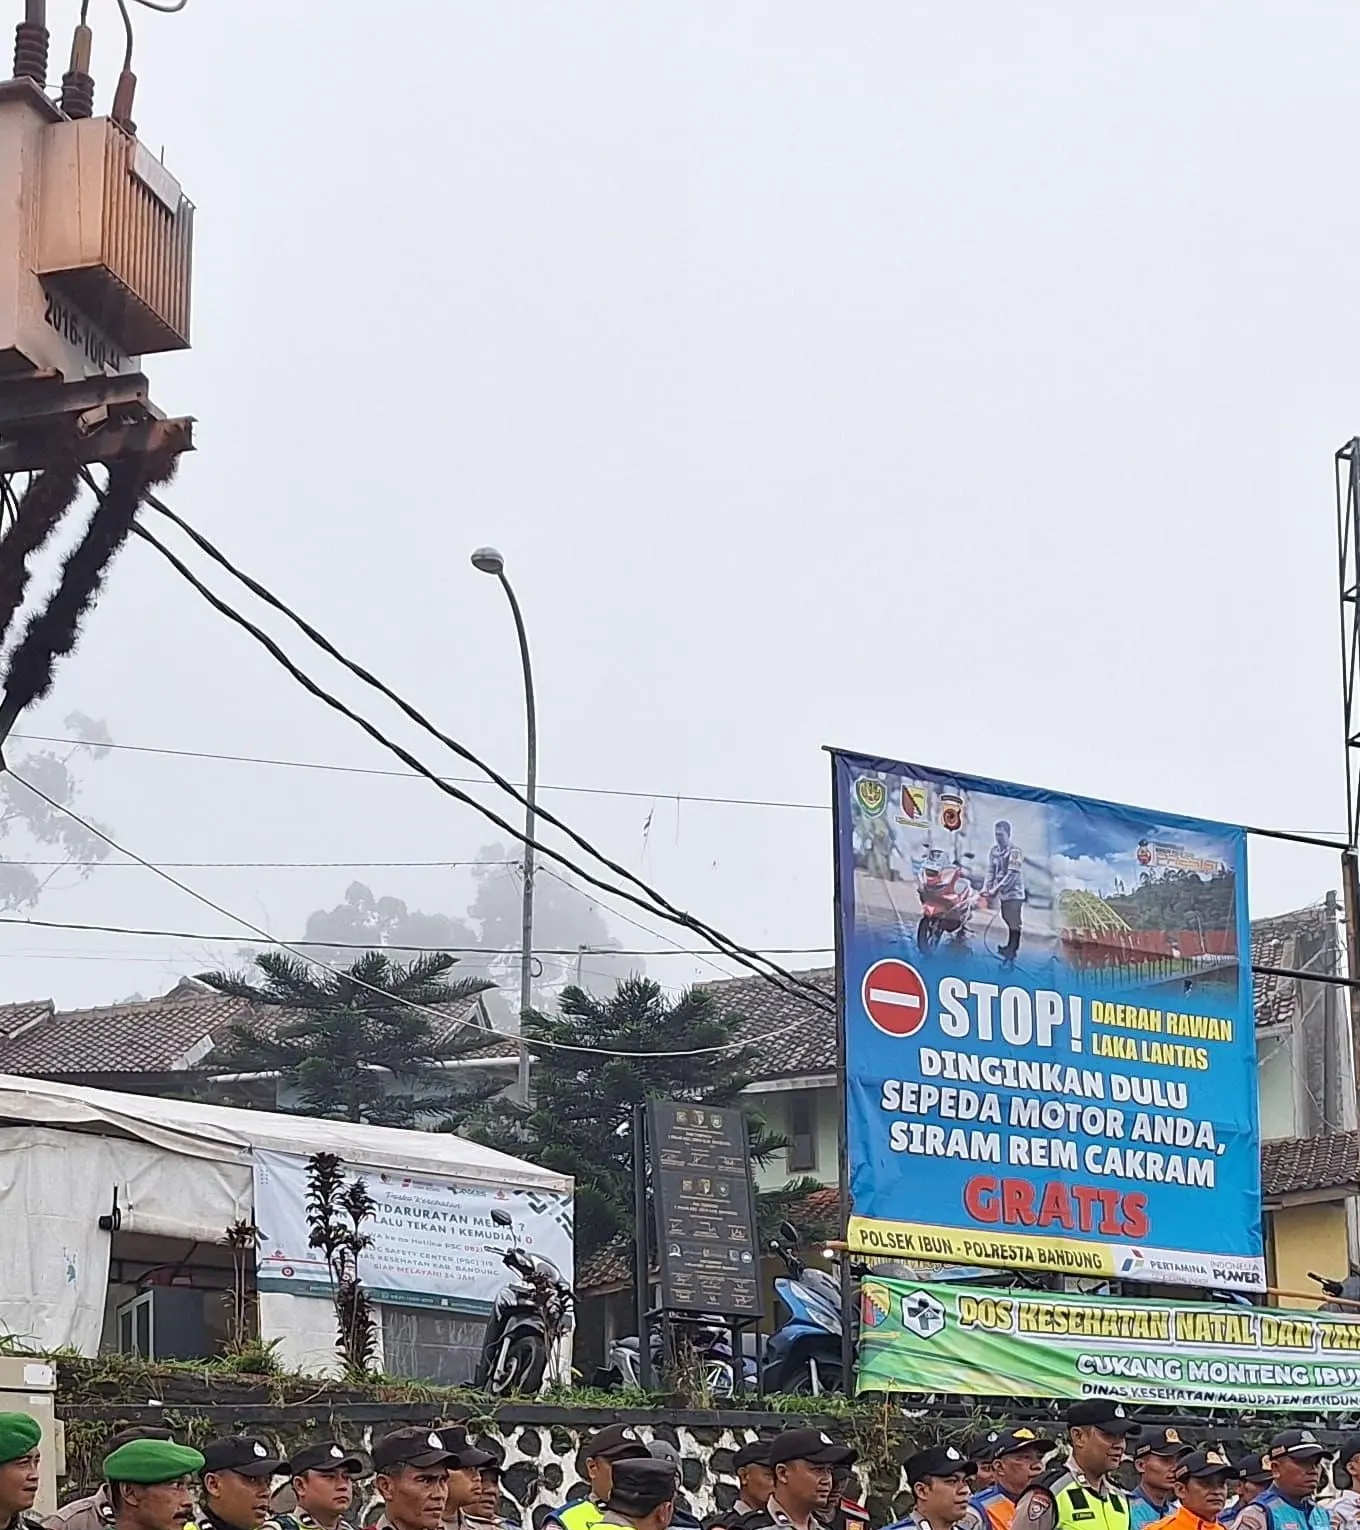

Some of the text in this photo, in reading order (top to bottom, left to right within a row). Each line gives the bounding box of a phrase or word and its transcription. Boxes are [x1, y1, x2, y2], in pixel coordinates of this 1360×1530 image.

[938, 977, 1082, 1053] STOP!
[1091, 1000, 1233, 1042] DAERAH RAWAN
[1092, 1034, 1209, 1071] LAKA LANTAS
[920, 1047, 1188, 1110] DINGINKAN DULU
[880, 1079, 1226, 1155] SEPEDA MOTOR ANDA,
[889, 1120, 1215, 1188] SIRAM REM CAKRAM
[376, 1203, 468, 1225] TDARURATAN
[963, 1176, 1150, 1238] GRATIS
[374, 1217, 402, 1227] LALU
[408, 1221, 447, 1234] TEKAN
[459, 1229, 521, 1243] KEMUDIAN
[860, 1229, 915, 1250] POLSEK
[918, 1236, 953, 1254] IBUN
[964, 1240, 1035, 1262] POLRESTA
[1038, 1247, 1103, 1269] BANDUNG
[1150, 1260, 1207, 1275] PERTAMINA
[1213, 1269, 1261, 1284] POWER
[959, 1296, 1014, 1330] POS
[1018, 1302, 1170, 1340] KESEHATAN
[1175, 1311, 1257, 1345] NATAL
[1261, 1317, 1313, 1348] DAN
[1076, 1354, 1182, 1381] CUKANG
[1186, 1361, 1309, 1386] MONTENG
[1082, 1383, 1128, 1397] DINAS
[1131, 1387, 1216, 1401] KESEHATAN
[1218, 1392, 1300, 1406] KABUPATEN
